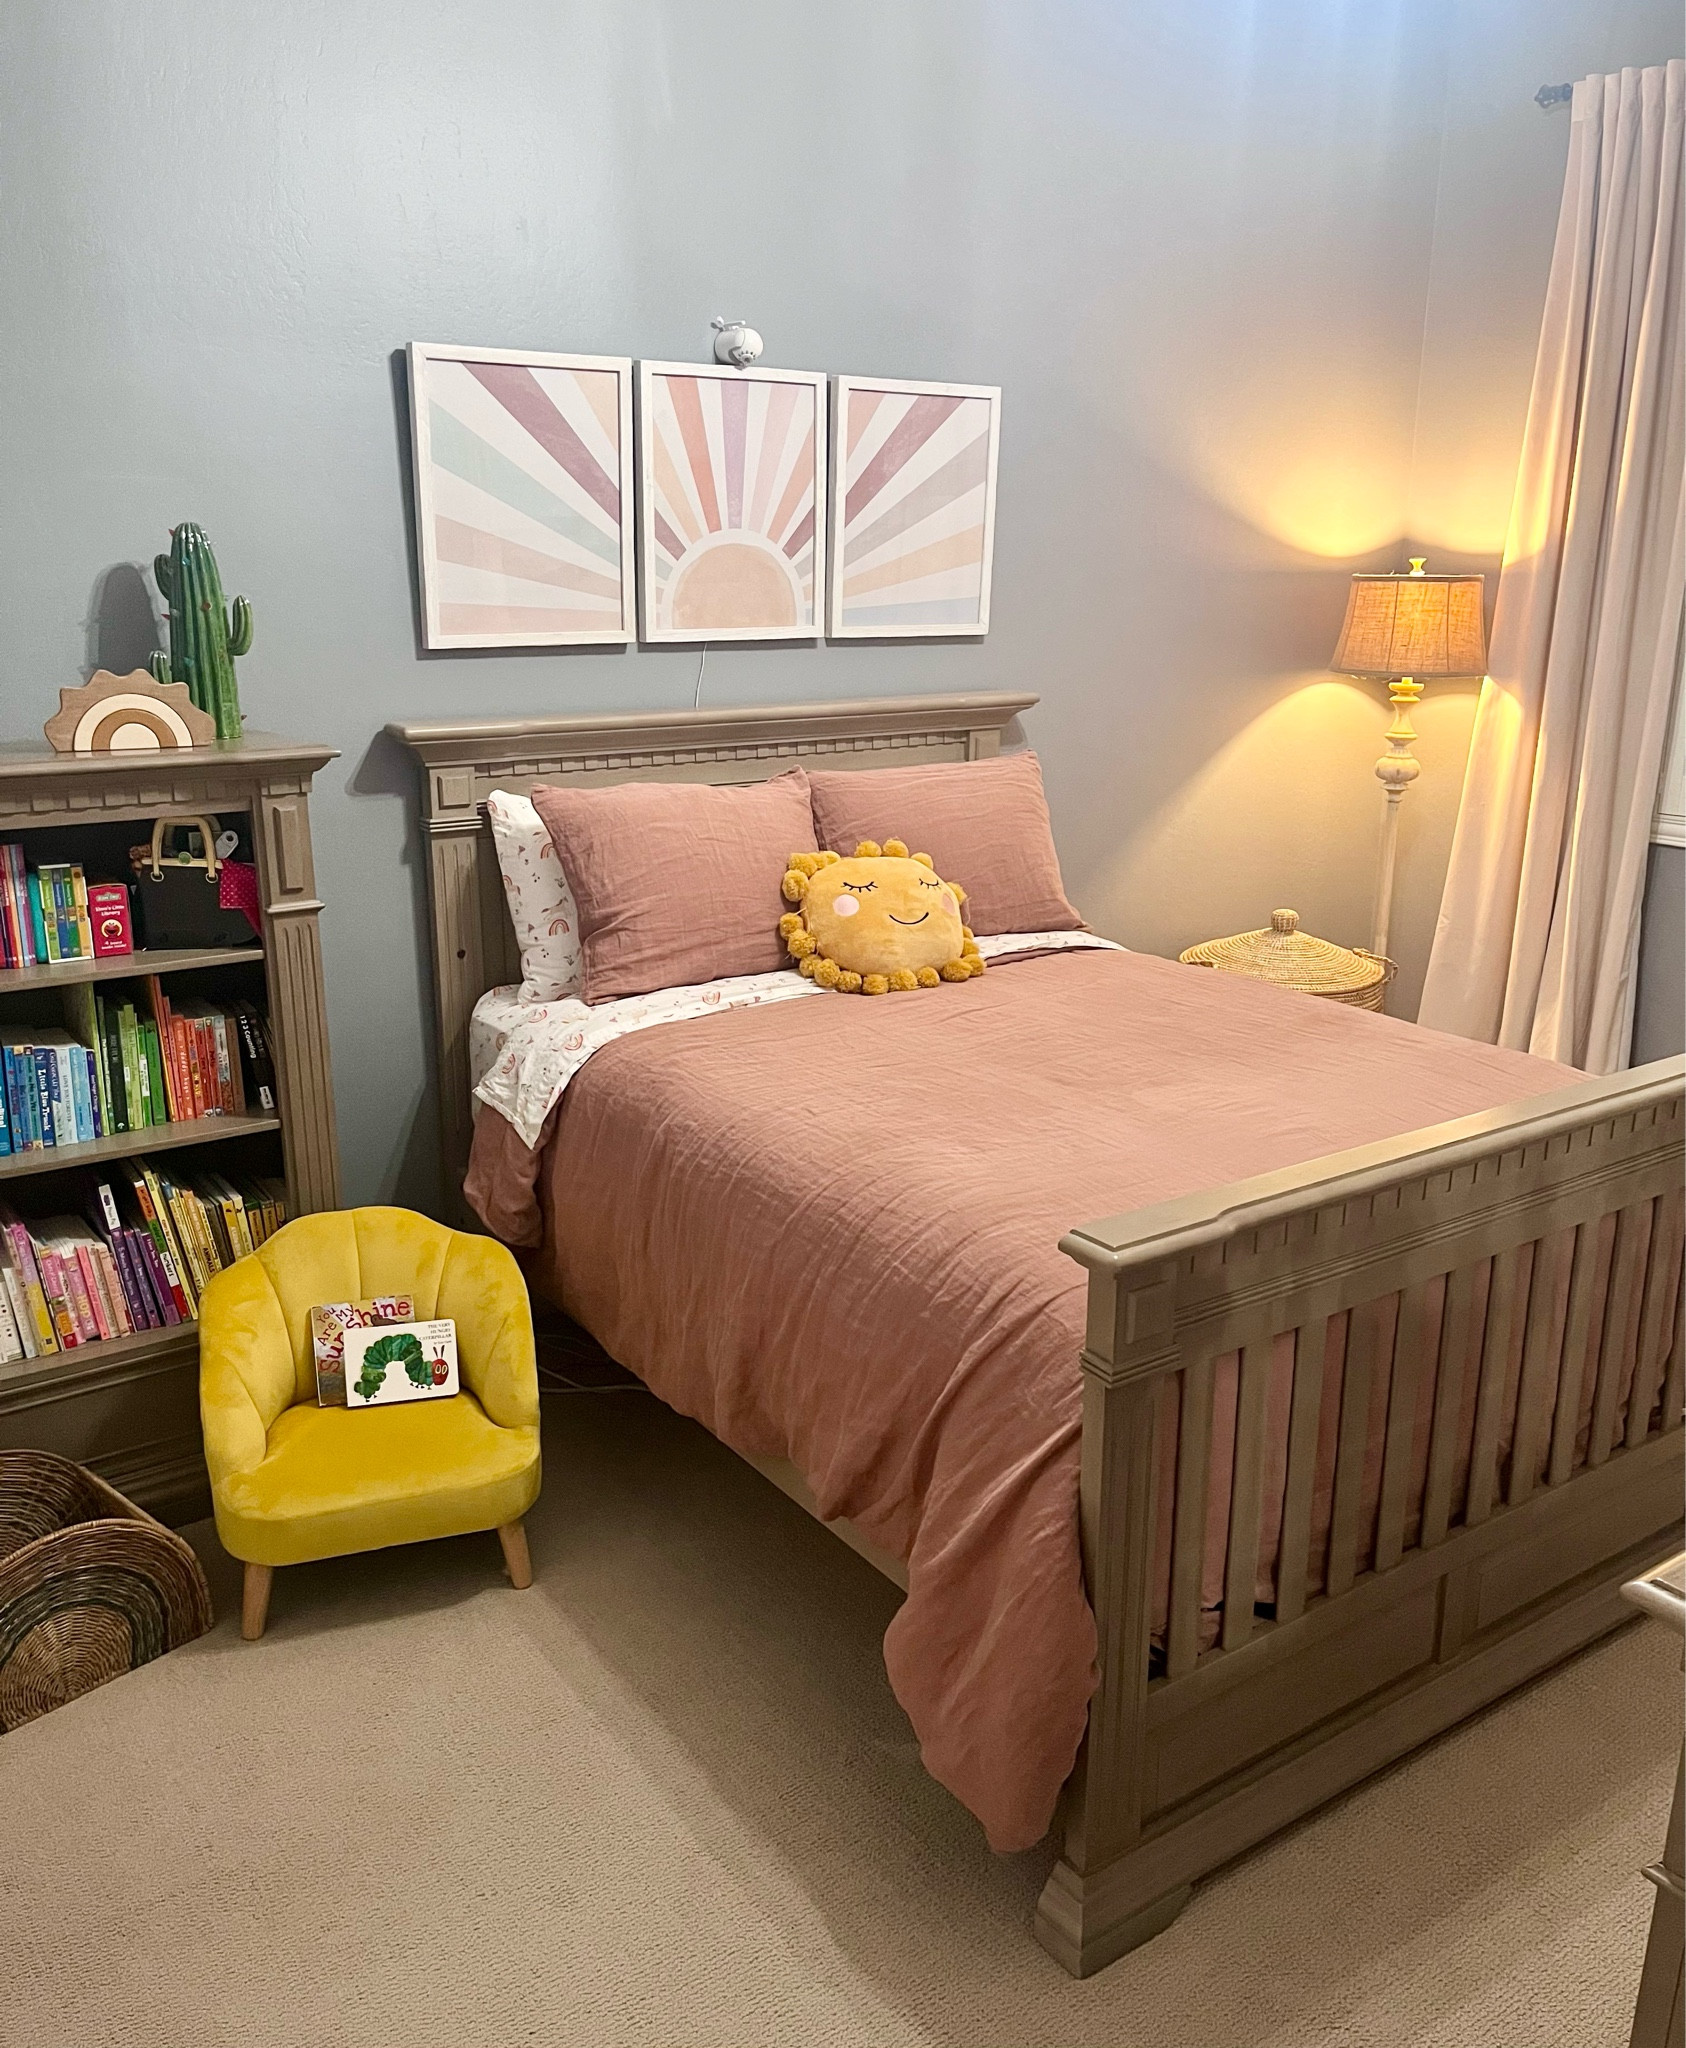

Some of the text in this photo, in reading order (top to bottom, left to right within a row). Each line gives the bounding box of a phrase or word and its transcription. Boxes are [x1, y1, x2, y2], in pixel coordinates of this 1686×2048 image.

[243, 1029, 256, 1059] Counting
[179, 1051, 190, 1093] daddy hugs
[37, 1069, 52, 1130] Little Blue Truck
[161, 1252, 174, 1276] numbers
[202, 1246, 214, 1272] ANIMALS
[76, 1294, 91, 1318] HOP
[316, 1307, 336, 1323] You
[336, 1304, 354, 1322] My
[318, 1322, 337, 1346] Are
